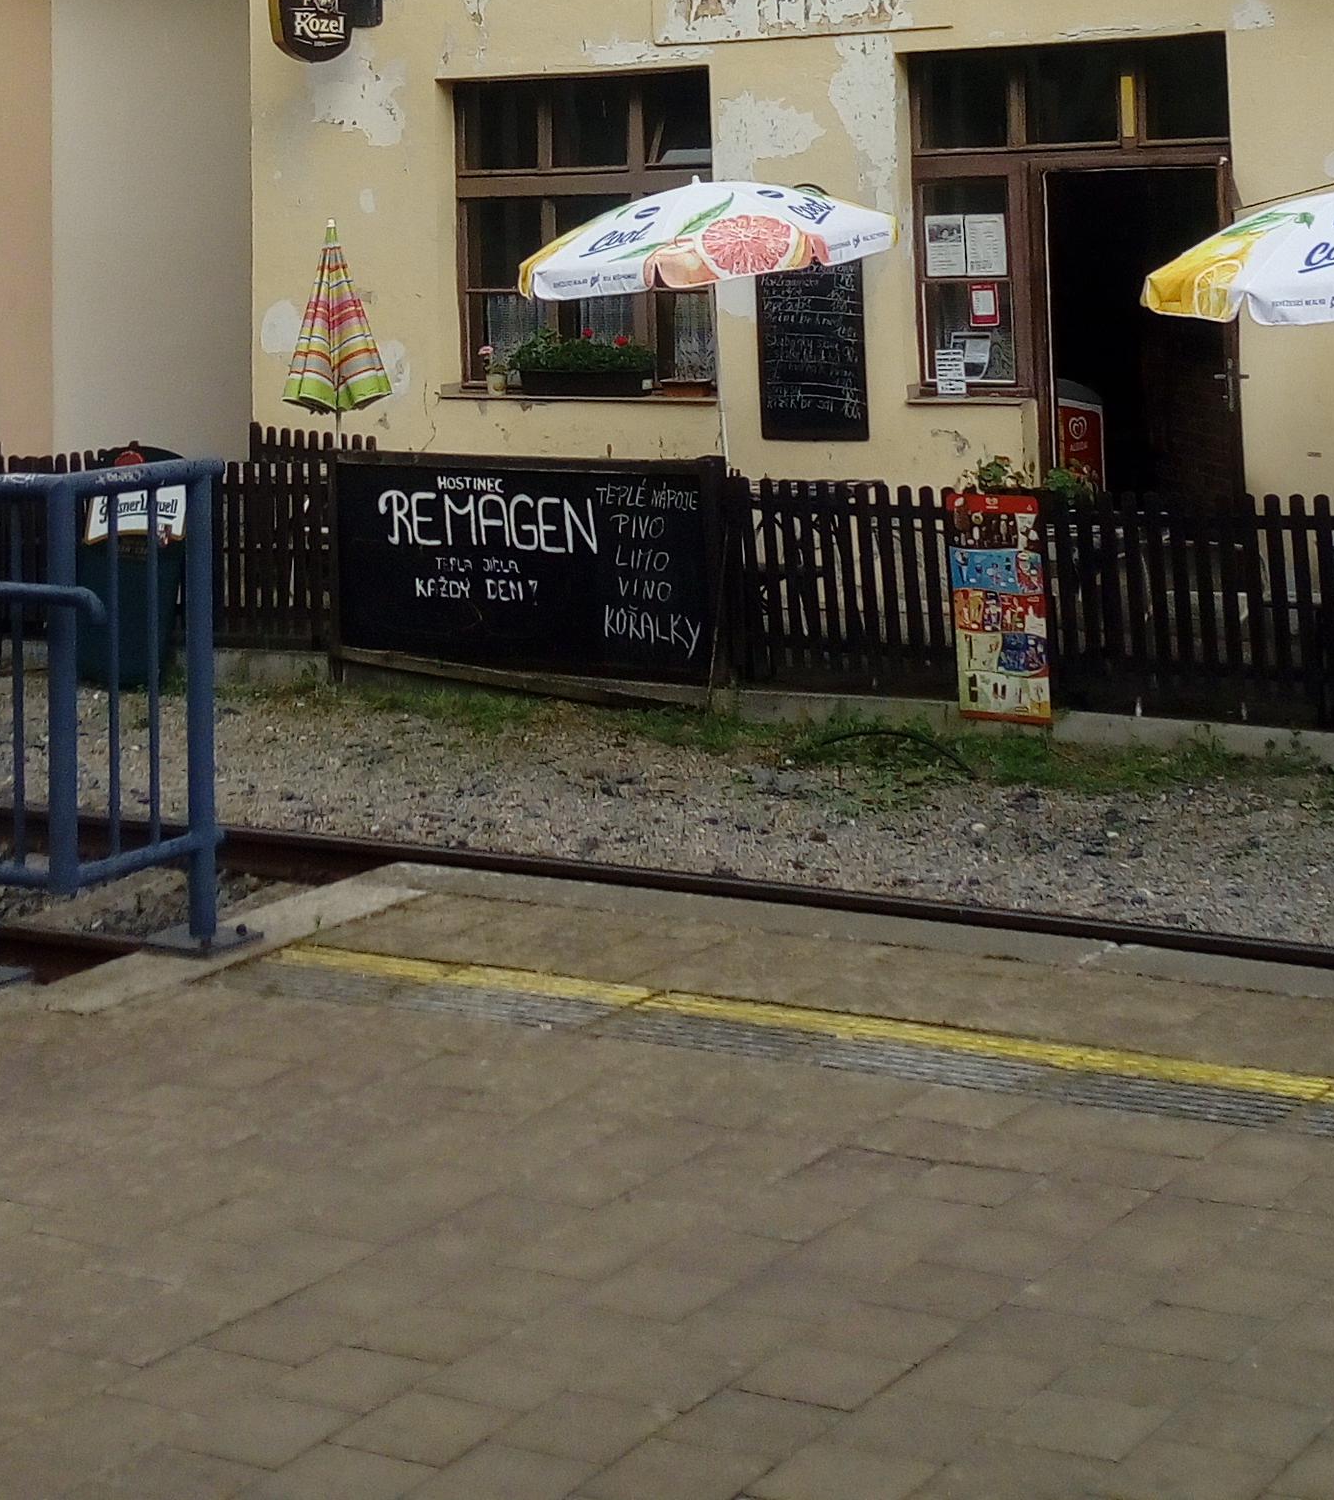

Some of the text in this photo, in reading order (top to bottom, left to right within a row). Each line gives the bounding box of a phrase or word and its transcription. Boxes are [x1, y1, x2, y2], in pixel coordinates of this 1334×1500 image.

[294, 11, 345, 39] Kozel
[437, 476, 504, 494] HOSTINEC
[595, 478, 699, 512] TEPLÉ NÁPOJE
[378, 490, 598, 555] REMAGEN
[609, 513, 665, 540] PIVO
[615, 544, 670, 573] LIMO
[618, 575, 673, 602] VINO
[604, 603, 701, 660] KOŘALKY
